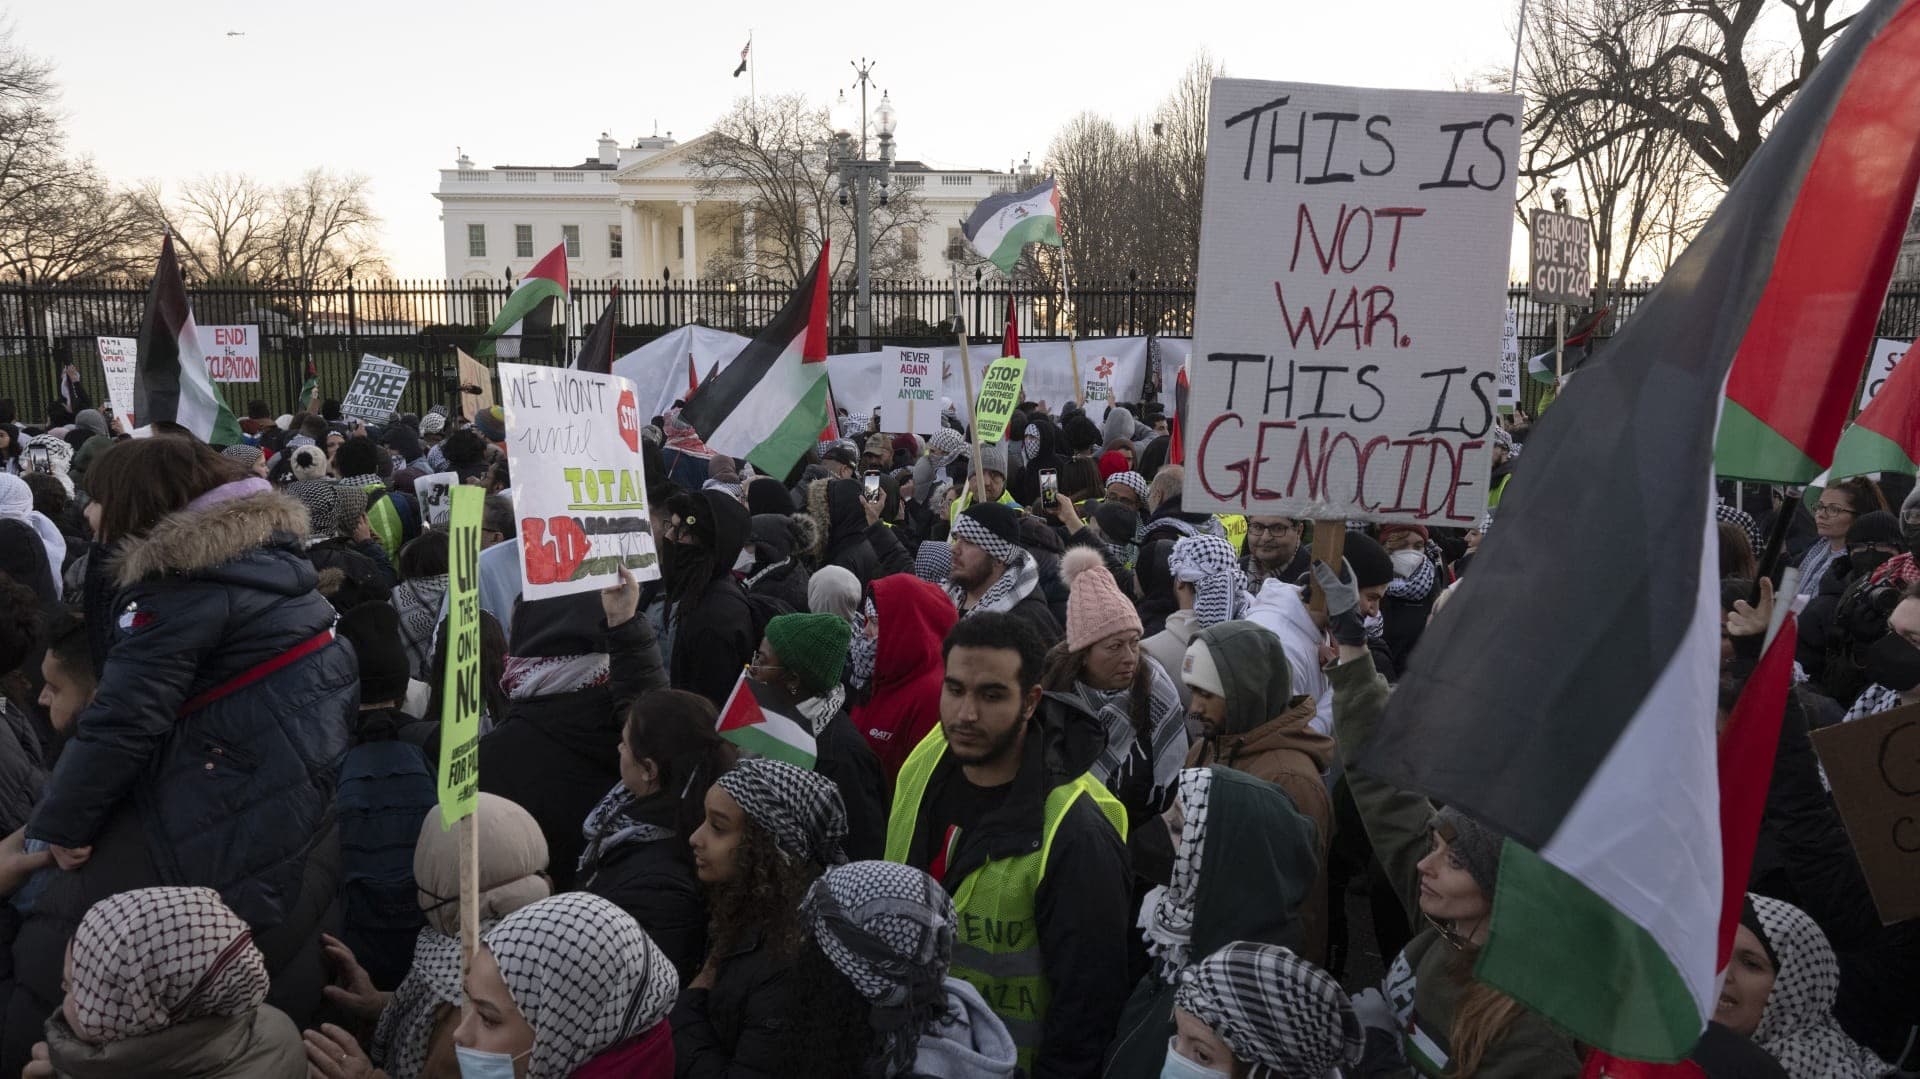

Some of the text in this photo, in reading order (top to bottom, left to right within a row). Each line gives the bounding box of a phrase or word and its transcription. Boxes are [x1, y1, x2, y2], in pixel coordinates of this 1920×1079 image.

[1225, 95, 1515, 191] THIS IS
[1289, 203, 1427, 274] NOT
[1536, 213, 1589, 248] GENOCIDE
[1535, 238, 1588, 271] JOE HAS
[1274, 281, 1412, 350] WAR.
[215, 327, 248, 346] END!
[205, 355, 258, 379] CUPATION
[900, 351, 930, 363] NEVER
[900, 363, 928, 376] AGAIN
[351, 371, 407, 399] FREE
[903, 376, 921, 388] FOR
[985, 381, 1017, 392] FUNDING
[988, 366, 1021, 382] STOP
[346, 394, 397, 410] PALESTINE
[505, 369, 541, 409] WE
[552, 373, 606, 415] WON'T
[898, 388, 935, 401] ANYONE
[979, 397, 1012, 416] NOW
[982, 389, 1014, 400] APARTHEID
[1207, 353, 1496, 439] THIS IS
[518, 418, 597, 462] until
[1197, 412, 1485, 521] GENOCIDE
[458, 595, 473, 627] THE
[457, 628, 472, 664] ON
[447, 757, 467, 789] FOR
[963, 912, 1024, 948] END
[966, 977, 1038, 1017] AZA
